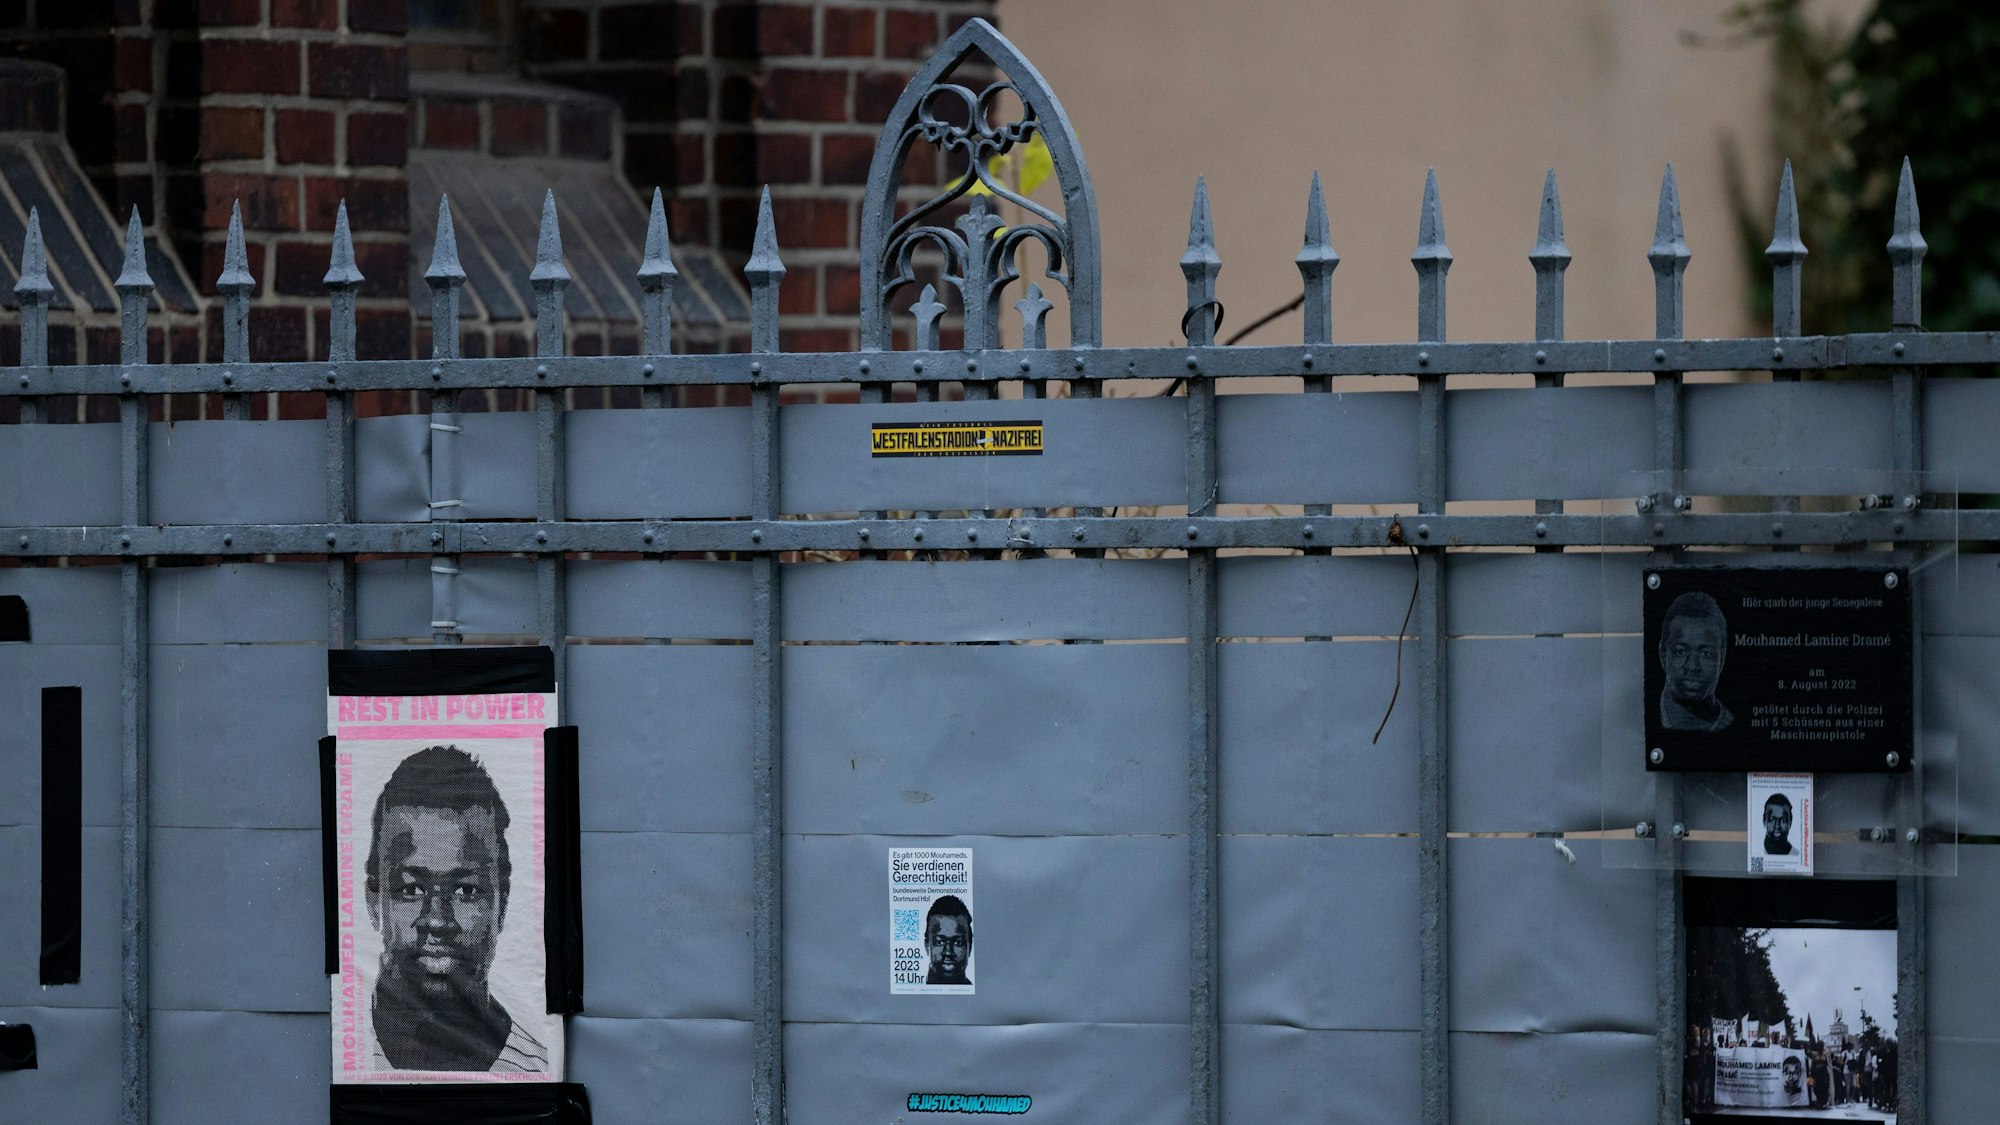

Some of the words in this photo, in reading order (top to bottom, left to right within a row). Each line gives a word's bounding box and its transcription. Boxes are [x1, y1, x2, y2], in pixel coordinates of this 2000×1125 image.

[872, 430, 978, 449] WESTFALENSTADION
[992, 429, 1042, 448] NAZIFREI
[1742, 598, 1761, 607] Hier
[1764, 598, 1787, 607] starb
[1788, 598, 1803, 607] der
[1804, 598, 1830, 609] junge
[1832, 598, 1883, 609] Senegalese
[1734, 633, 1801, 646] Mouhamed
[1804, 633, 1849, 646] Lamine
[1852, 633, 1891, 646] Dramé
[1808, 668, 1825, 677] am
[1778, 680, 1787, 689] 8.
[1792, 680, 1828, 691] August
[1832, 680, 1857, 689] 2022
[338, 695, 404, 722] REST
[411, 694, 439, 721] IN
[446, 694, 545, 720] POWER
[1752, 704, 1789, 716] getötet
[1792, 704, 1823, 714] durch
[1827, 704, 1843, 714] die
[1847, 704, 1883, 714] Polizei
[1751, 718, 1769, 727] mit
[1772, 718, 1778, 727] 5
[1782, 716, 1832, 727] Schüssen
[1836, 719, 1854, 727] aus
[1858, 718, 1885, 727] einer
[1770, 730, 1866, 742] Maschinenpistole
[902, 852, 912, 860] gibt
[892, 860, 910, 870] Sie
[912, 860, 964, 870] verdienen
[892, 871, 968, 884] Gerechtigkeit!
[340, 841, 354, 926] LAMINE
[894, 948, 923, 958] 12.08.
[894, 960, 920, 970] 2023
[894, 972, 905, 984] 14
[907, 972, 924, 984] Uhr
[341, 932, 356, 1070] MOUHAMED
[1718, 1060, 1754, 1070] MOUHAMED
[389, 1073, 404, 1081] VON
[406, 1073, 420, 1081] DER
[505, 1073, 552, 1081] ERSCHOSSEN
[908, 1094, 1031, 1113] #JUSTICE4MOUHAMED
